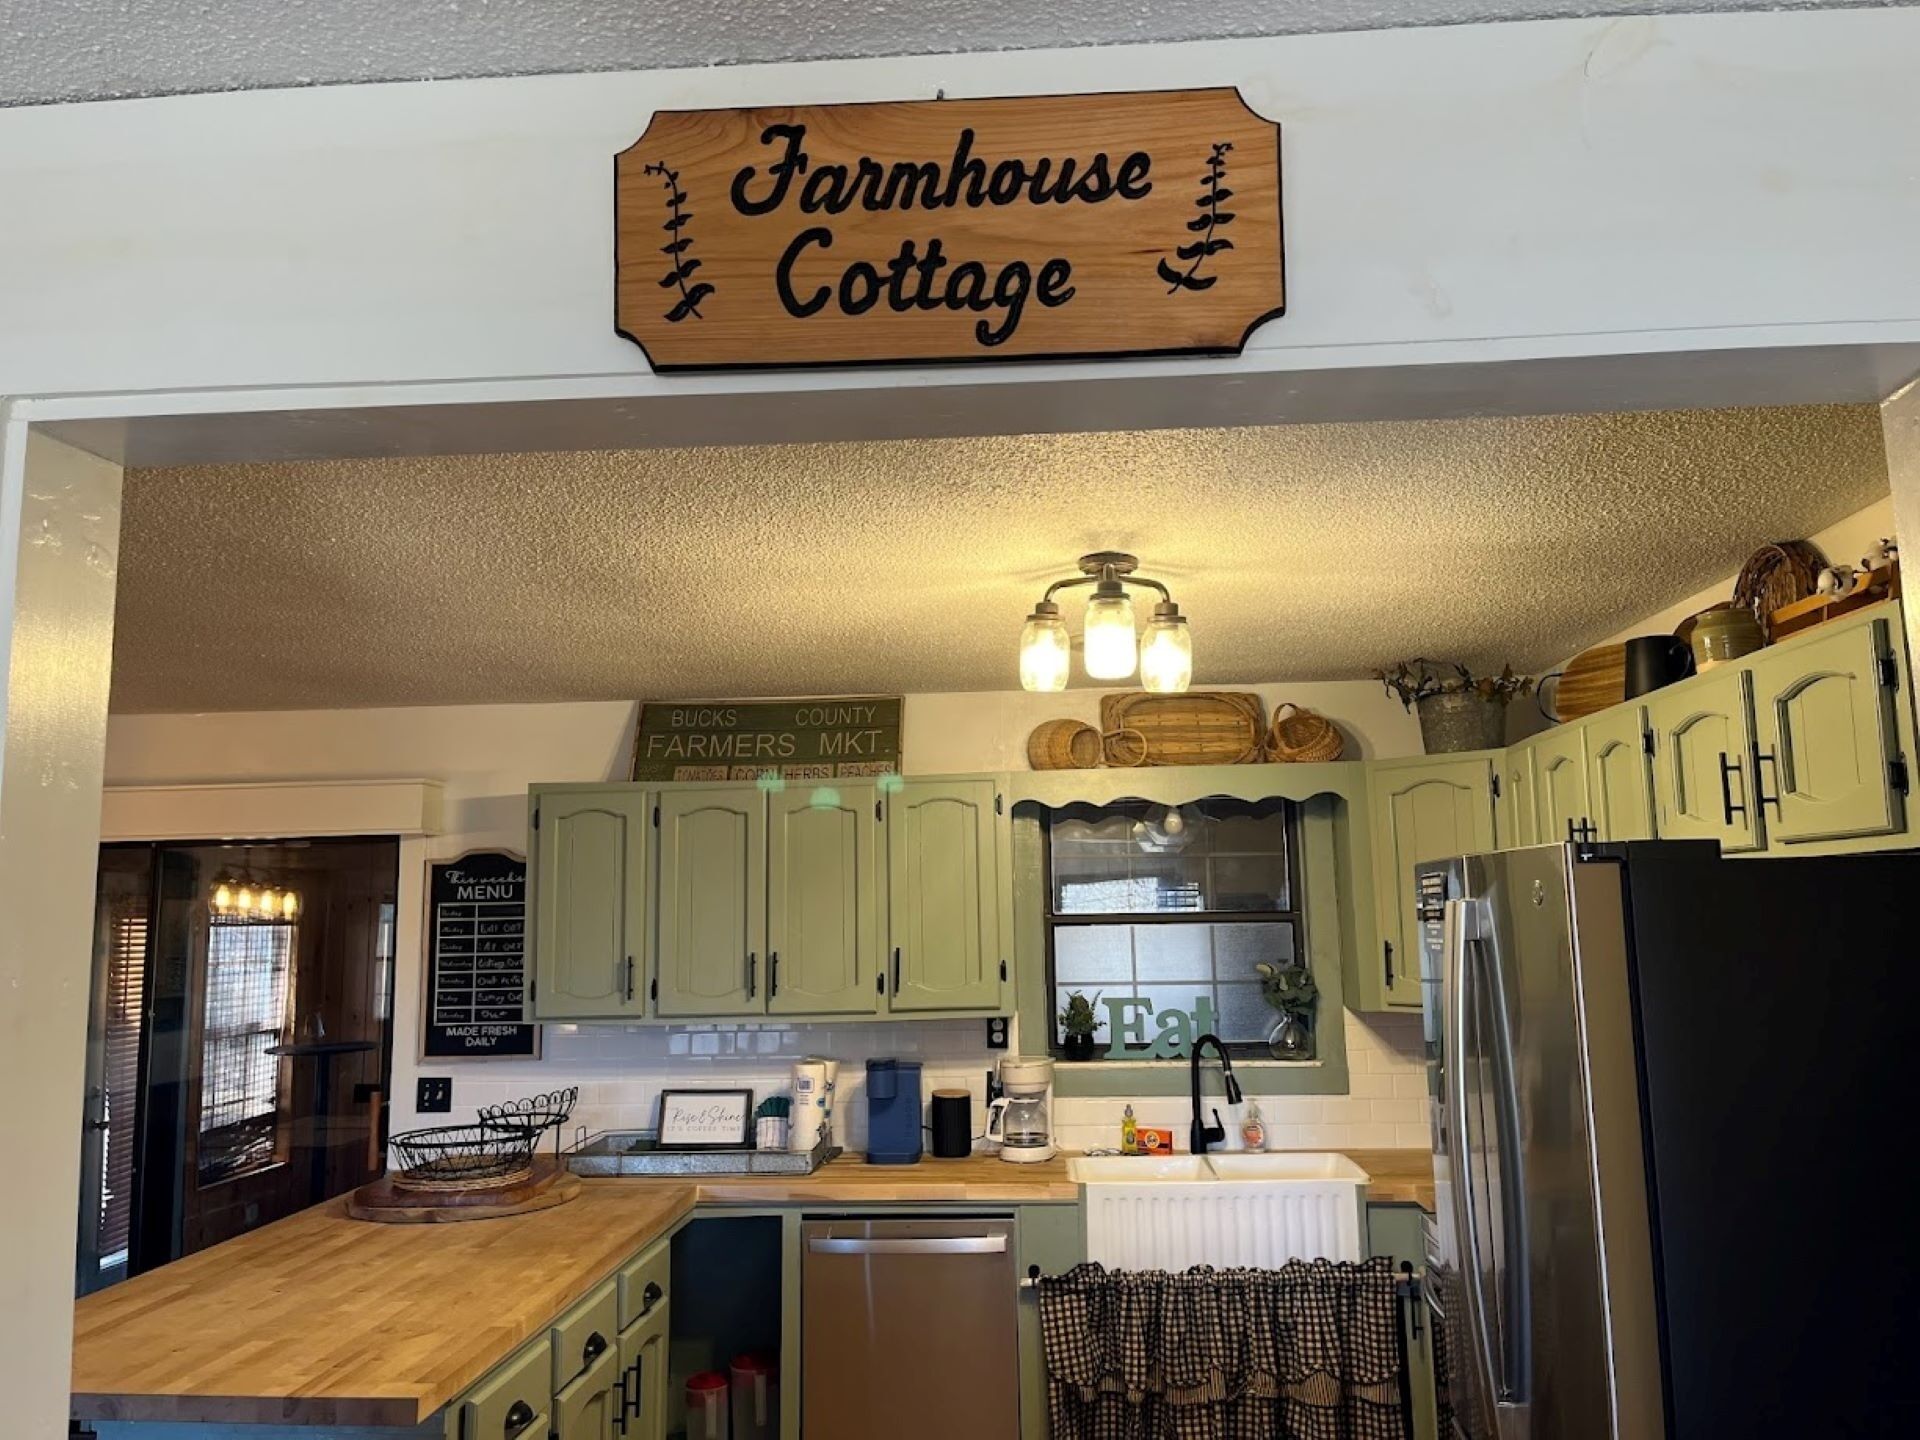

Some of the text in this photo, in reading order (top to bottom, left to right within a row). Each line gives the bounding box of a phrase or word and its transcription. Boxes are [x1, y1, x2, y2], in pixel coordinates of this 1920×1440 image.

[731, 124, 1153, 216] Farmhouse
[776, 227, 1076, 347] Cottage
[671, 706, 877, 728] BUCKS COUNTY
[646, 732, 796, 758] FARMERS
[735, 767, 779, 780] CORN
[456, 884, 514, 900] MENU
[446, 1025, 518, 1037] MADE FRESH
[1100, 995, 1219, 1060] Eat
[464, 1036, 498, 1048] DAILY
